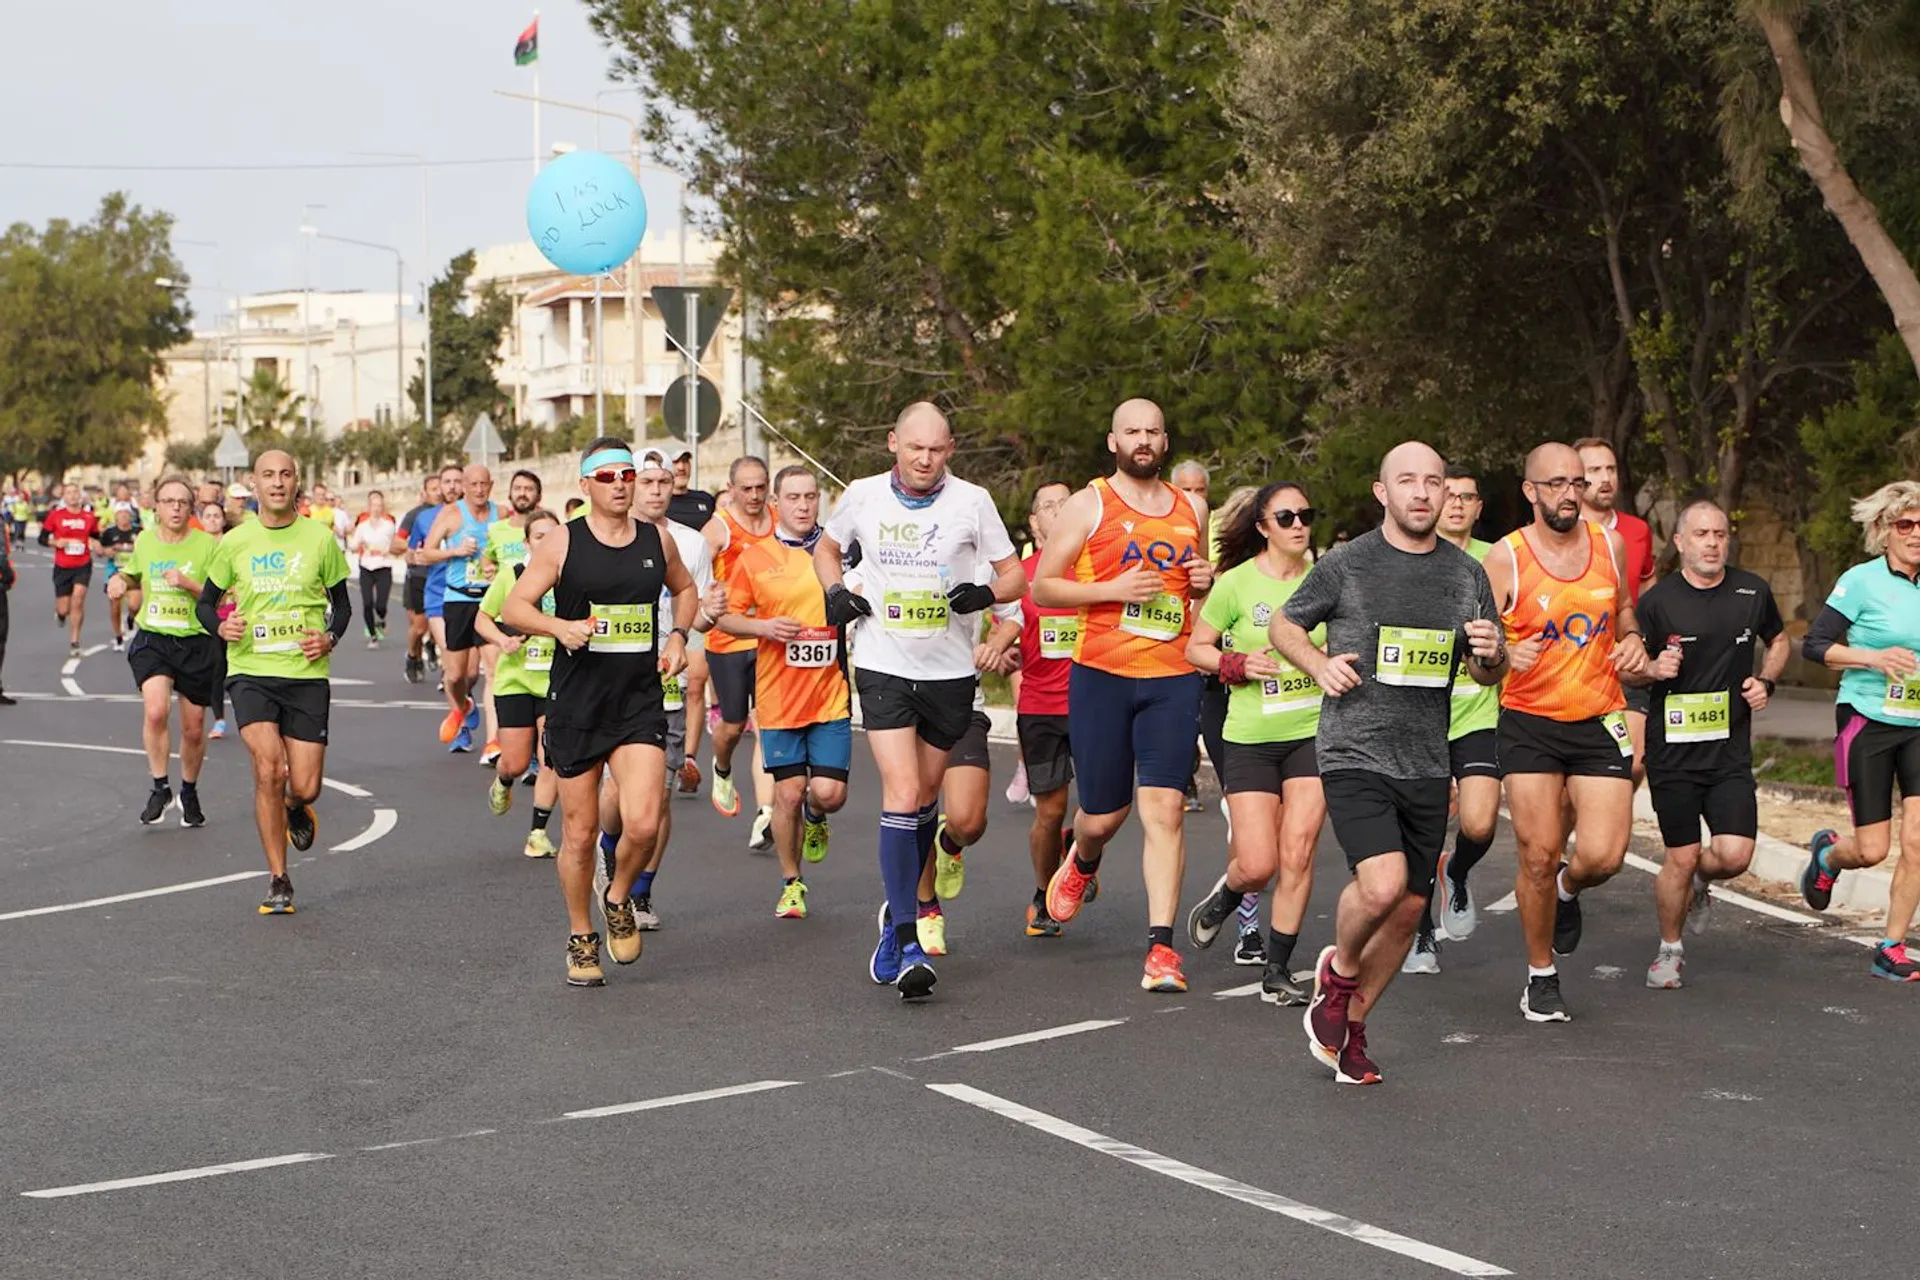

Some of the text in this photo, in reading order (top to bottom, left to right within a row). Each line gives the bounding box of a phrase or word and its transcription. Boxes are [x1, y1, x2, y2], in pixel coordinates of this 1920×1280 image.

[578, 192, 631, 230] LUCK
[879, 521, 919, 542] MC
[252, 552, 286, 571] MC
[879, 550, 913, 558] MALTA
[880, 558, 938, 567] MARATHON
[907, 607, 946, 620] 1672
[1146, 608, 1181, 624] 1545
[271, 624, 304, 637] 1614
[614, 622, 651, 634] 1632
[1541, 611, 1609, 648] AQA
[790, 644, 832, 663] 3361
[1407, 650, 1449, 665] 1759
[1689, 710, 1724, 724] 1481
